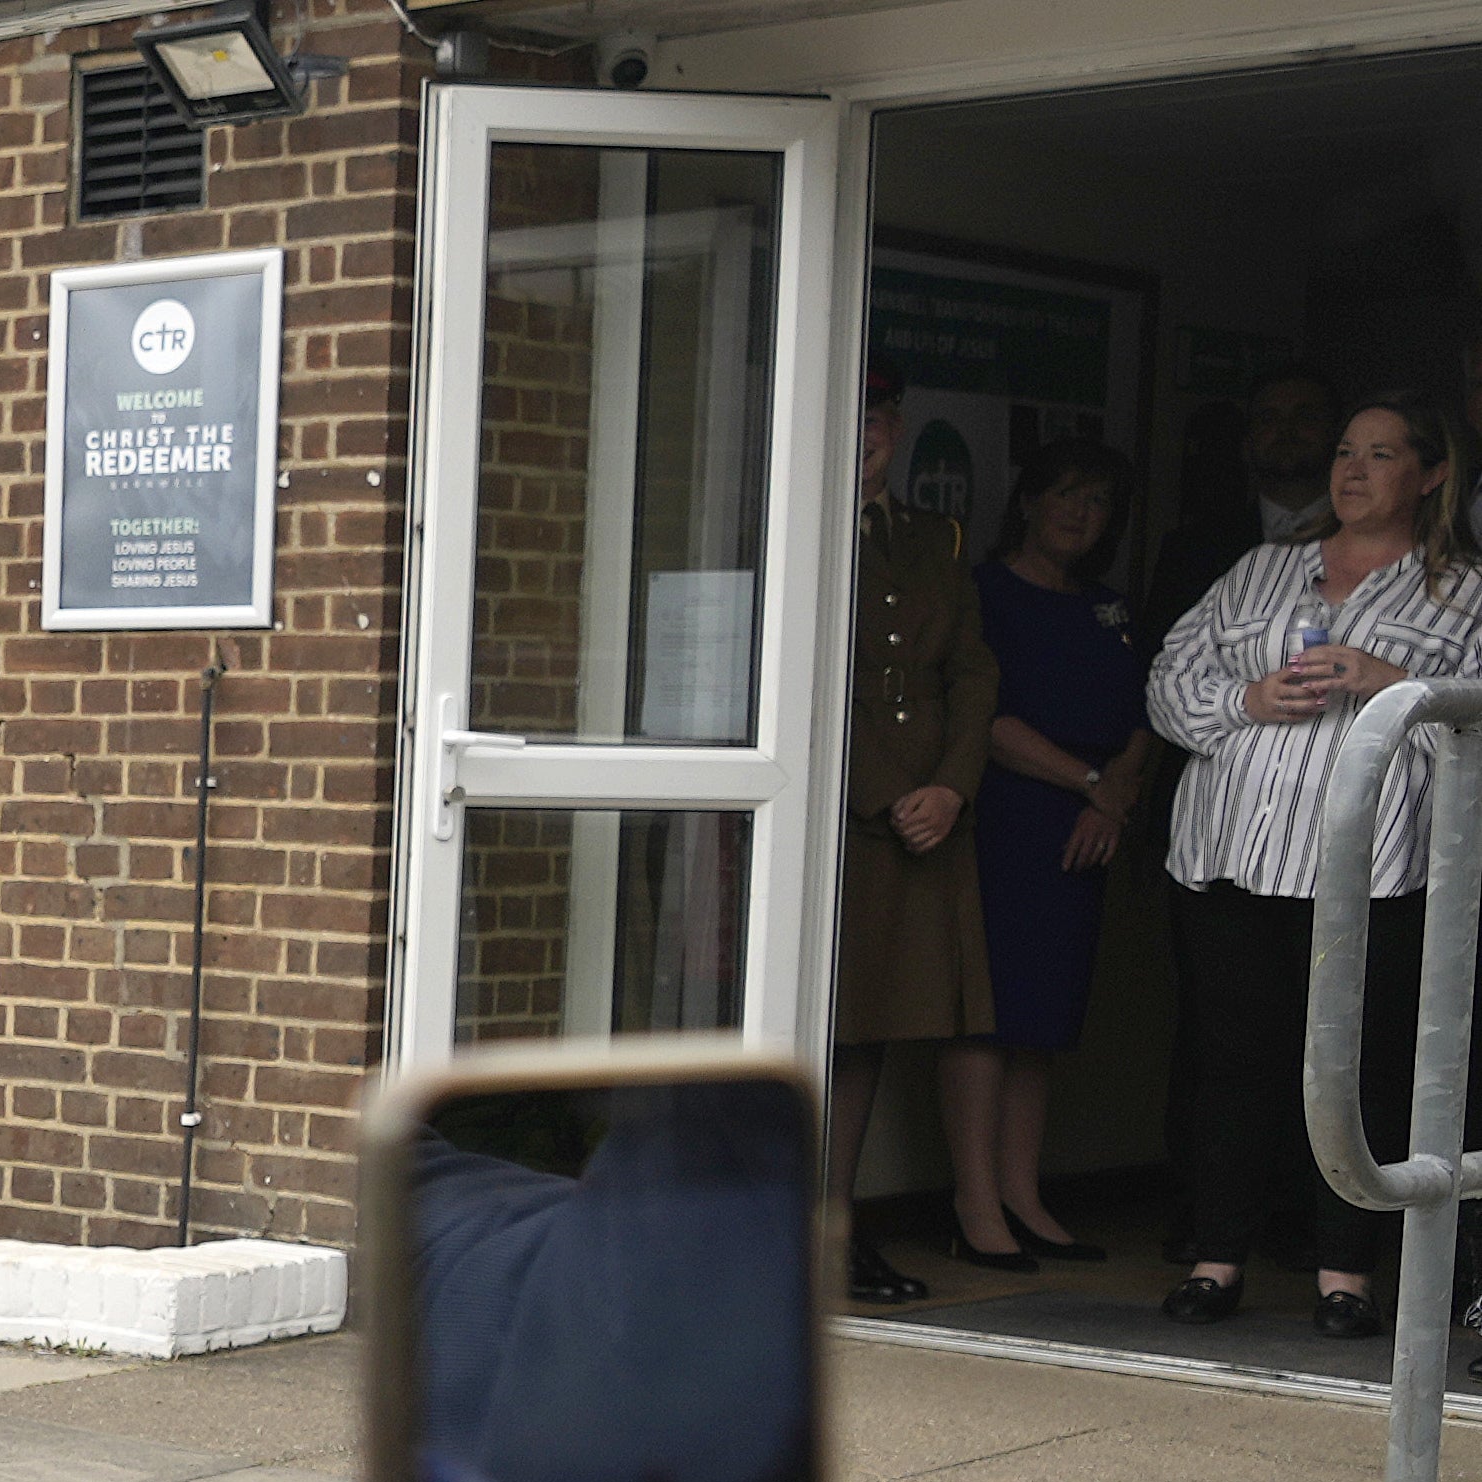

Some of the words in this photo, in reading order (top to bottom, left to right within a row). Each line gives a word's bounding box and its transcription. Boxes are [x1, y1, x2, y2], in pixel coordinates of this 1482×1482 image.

[117, 387, 204, 411] WELCOME
[151, 413, 167, 425] TO
[85, 427, 174, 449] CHRIST
[185, 423, 234, 444] THE
[85, 444, 232, 477] REDEEMER
[110, 517, 200, 536] TOGETHER:
[115, 540, 157, 556] LOVING
[159, 539, 195, 554] JESUS
[112, 557, 155, 572] LOVING
[156, 555, 197, 571] PEOPLE
[111, 573, 162, 589] SHARING
[163, 572, 198, 588] JESUS
